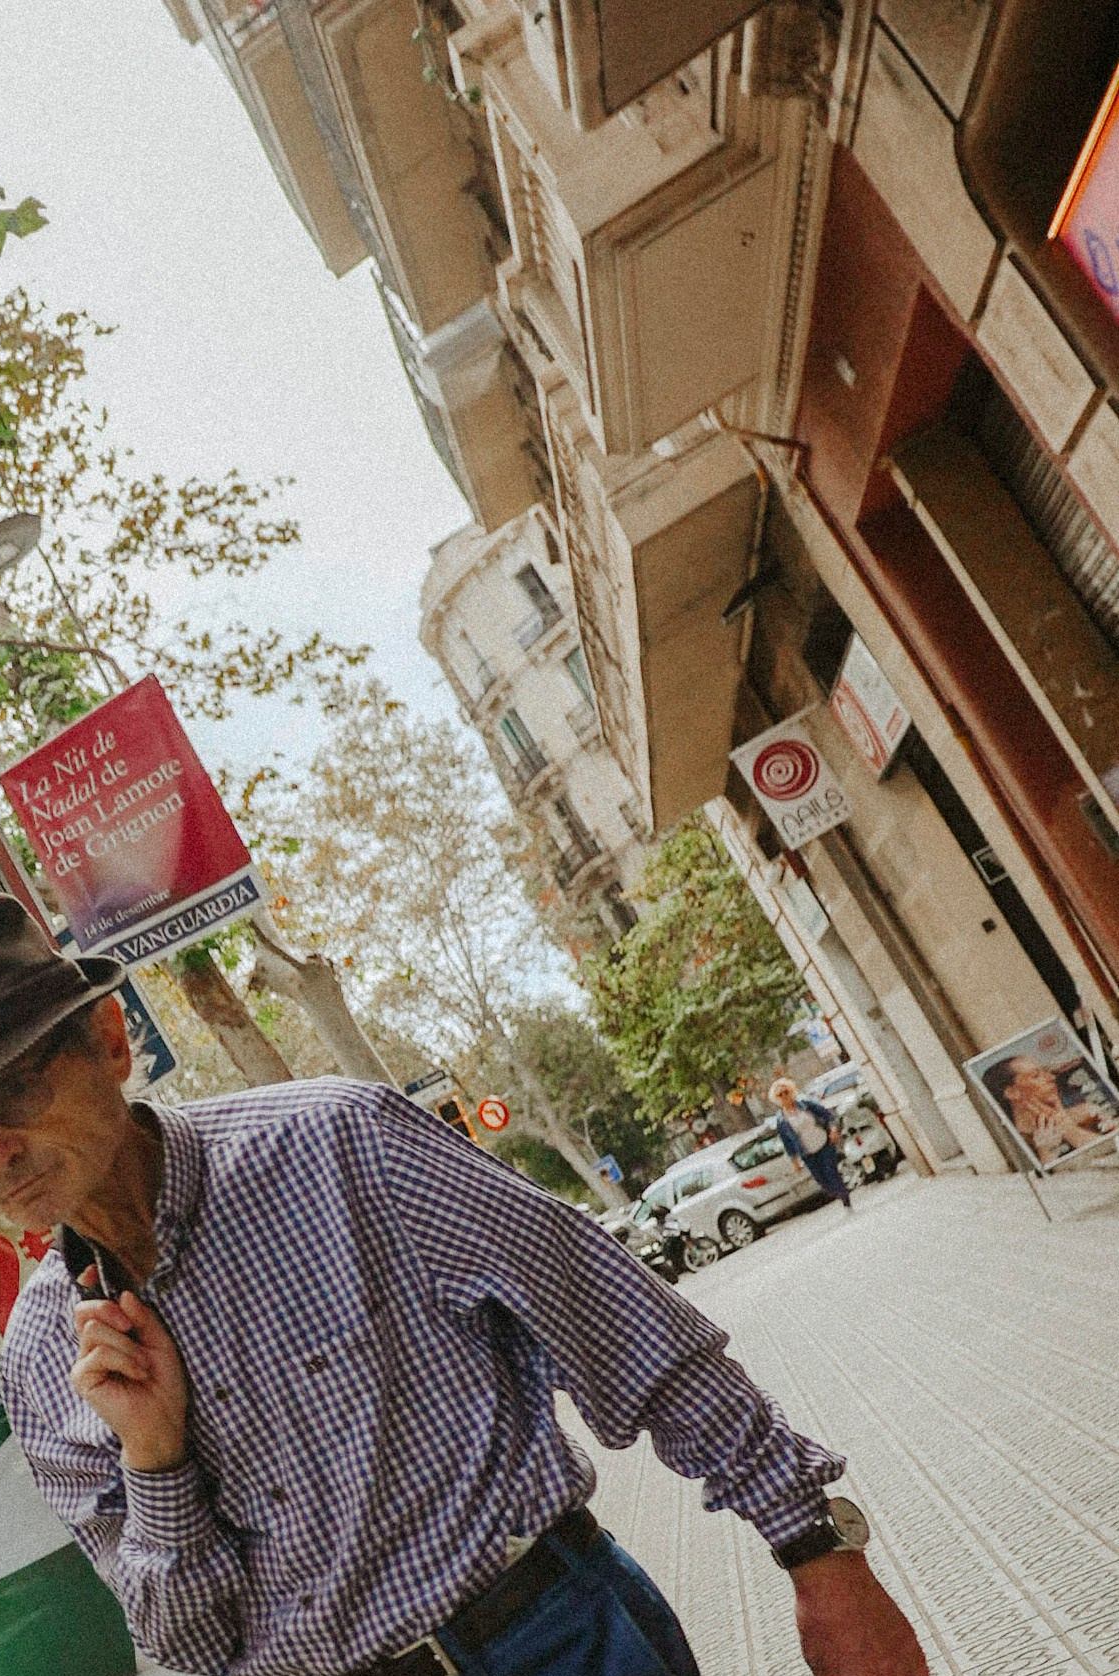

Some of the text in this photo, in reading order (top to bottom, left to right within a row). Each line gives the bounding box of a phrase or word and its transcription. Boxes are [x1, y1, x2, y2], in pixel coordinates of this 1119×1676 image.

[19, 730, 116, 804] La Nit de
[30, 758, 129, 829] Nadal de
[39, 757, 185, 860] Joan Lamote
[54, 792, 184, 877] de Grignon
[123, 882, 255, 964] VANGUARDIA
